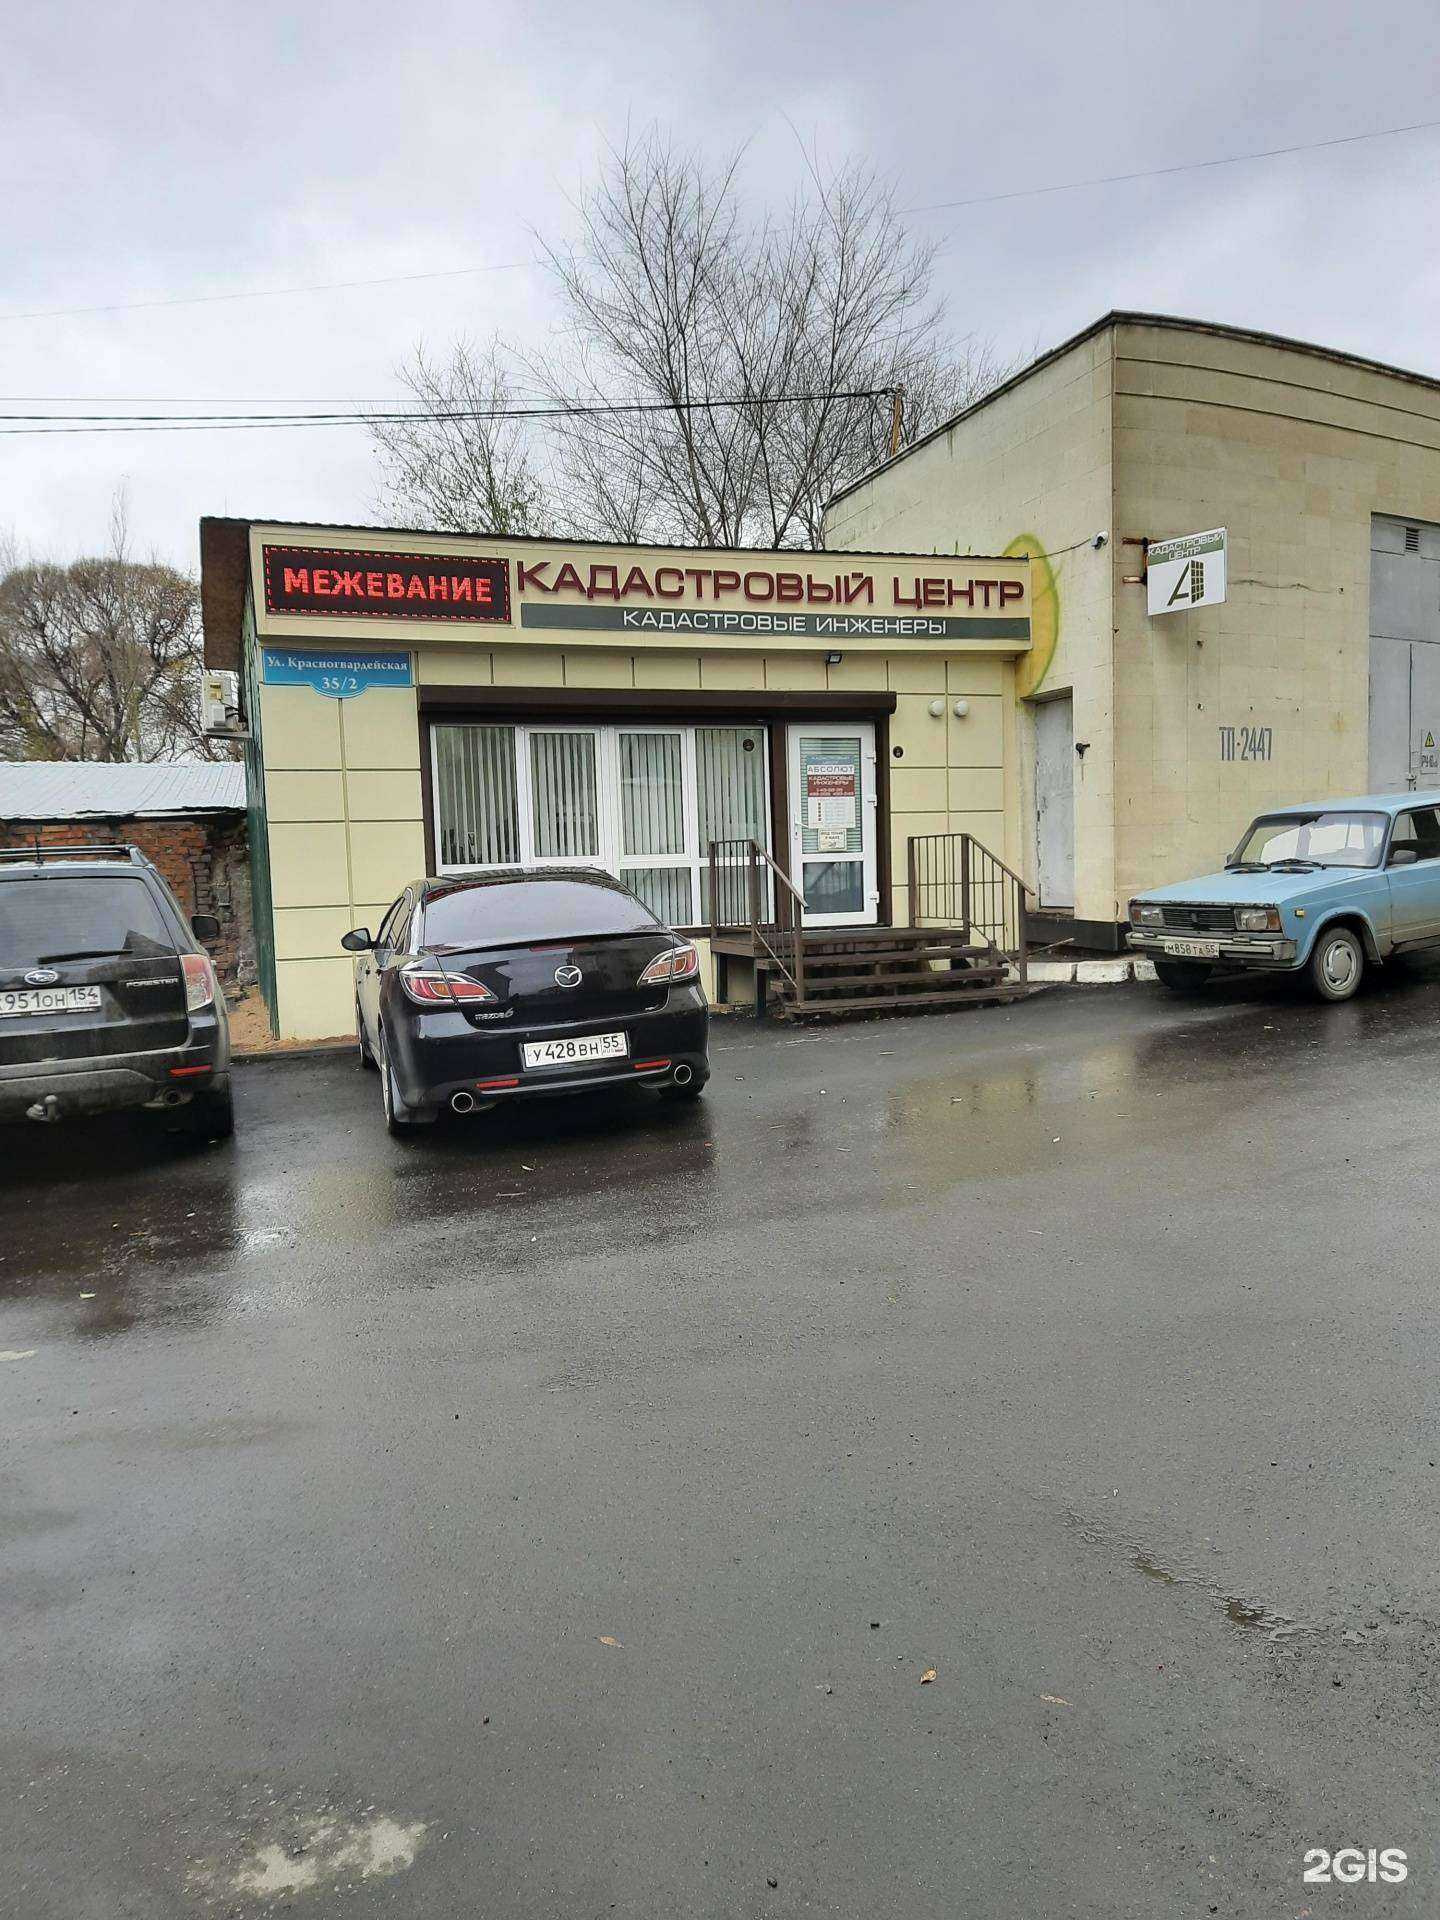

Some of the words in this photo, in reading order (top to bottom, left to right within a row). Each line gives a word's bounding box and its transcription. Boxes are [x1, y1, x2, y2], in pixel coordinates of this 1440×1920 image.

[1147, 532, 1224, 556] КАДАСТРОВЫЙ
[1168, 546, 1201, 560] ЦЕНТР
[283, 566, 493, 602] МЕЖЕВАНИЕ
[516, 560, 874, 604] КАДАСТРОВЫЙ
[893, 576, 1025, 609] ЦЕНТР
[623, 610, 806, 632] КАДАСТРОВЫЕ
[816, 616, 947, 635] ИНЖЕНЕРЫ
[267, 656, 285, 667] Ул.
[288, 656, 408, 673] Красногвардейская
[321, 676, 358, 690] 35/2
[126, 977, 179, 988] FORESTER
[68, 987, 99, 1001] 154
[603, 1035, 620, 1050] 55
